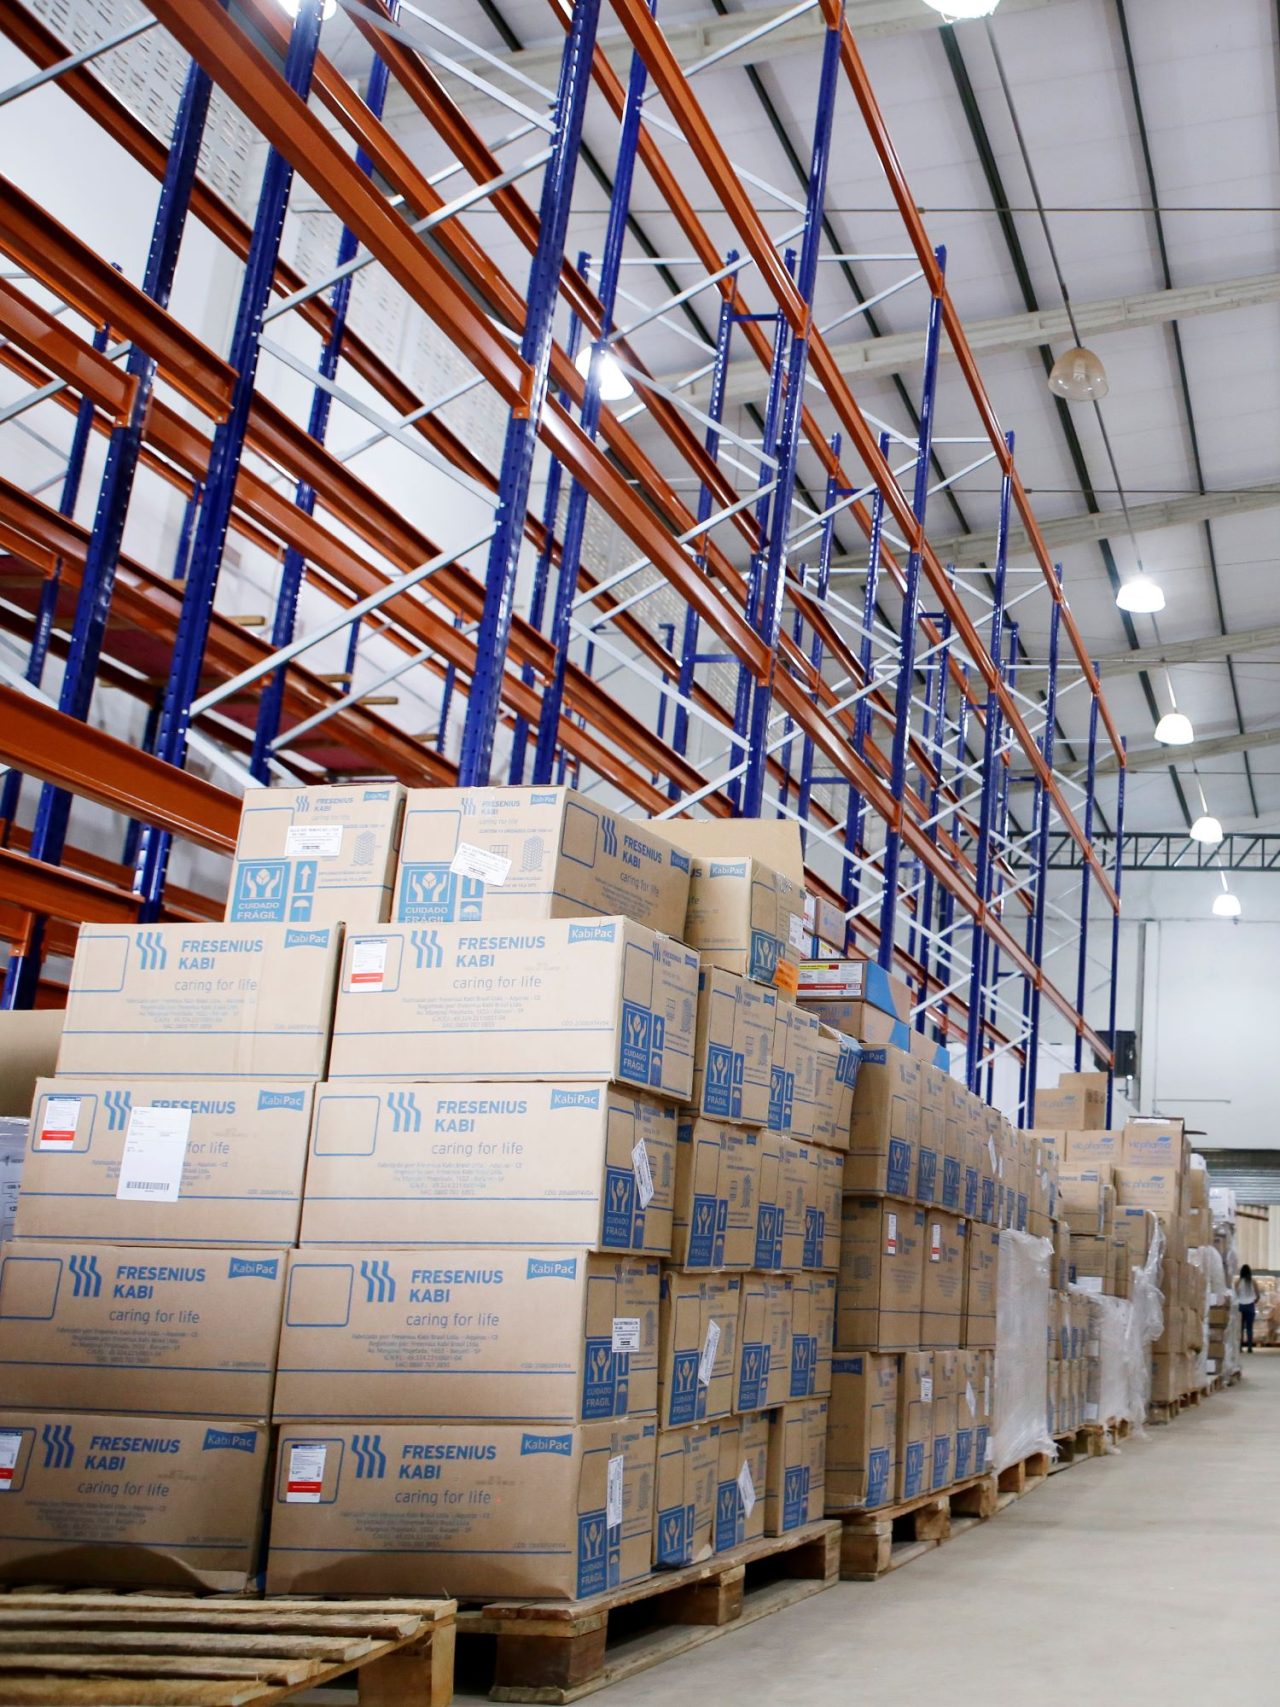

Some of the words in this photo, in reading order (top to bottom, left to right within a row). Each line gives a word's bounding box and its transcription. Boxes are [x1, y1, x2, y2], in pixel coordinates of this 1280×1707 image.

[623, 835, 663, 864] FRESENIUS
[622, 851, 641, 869] KABI
[712, 865, 746, 876] KabiPac
[619, 871, 640, 892] caring
[640, 877, 650, 891] for
[238, 902, 280, 910] CUIDADO
[405, 906, 449, 915] CUIDADO
[237, 910, 278, 920] FRÁGIL
[287, 933, 328, 944] KabiPac
[571, 927, 613, 939] KabiPac
[181, 939, 264, 953] FRESENIUS
[458, 935, 546, 950] FRESENIUS
[178, 957, 216, 970] KABI
[455, 953, 496, 969] KABI
[174, 979, 213, 994] caring
[216, 978, 235, 992] for
[238, 978, 259, 991] life
[452, 976, 493, 991] caring
[497, 975, 517, 989] for
[520, 974, 543, 988] life
[261, 1094, 303, 1106] KabiPac
[436, 1100, 528, 1114] FRESENIUS
[553, 1094, 597, 1105] KabiPac
[434, 1119, 475, 1133] KABI
[208, 1141, 230, 1154] life
[431, 1143, 473, 1157] caring
[477, 1142, 498, 1155] for
[501, 1141, 523, 1155] life
[115, 1265, 206, 1283] FRESENIUS
[232, 1263, 276, 1274] KabiPac
[530, 1263, 575, 1275] KabiPac
[411, 1269, 504, 1285] FRESENIUS
[113, 1284, 154, 1300] KABI
[408, 1288, 451, 1303] KABI
[109, 1309, 150, 1325] caring
[155, 1309, 175, 1323] for
[178, 1309, 200, 1324] life
[406, 1314, 449, 1329] caring
[453, 1313, 474, 1327] for
[477, 1312, 500, 1326] life
[89, 1436, 182, 1454] FRESENIUS
[207, 1435, 253, 1447] KabiPac
[524, 1438, 570, 1450] KabiPac
[402, 1444, 497, 1460] FRESENIUS
[84, 1455, 126, 1471] KABI
[398, 1464, 441, 1480] KABI
[77, 1481, 120, 1497] caring
[124, 1481, 143, 1496] for
[147, 1482, 170, 1498] life
[394, 1491, 438, 1506] caring
[443, 1490, 463, 1505] for
[468, 1490, 492, 1505] life
